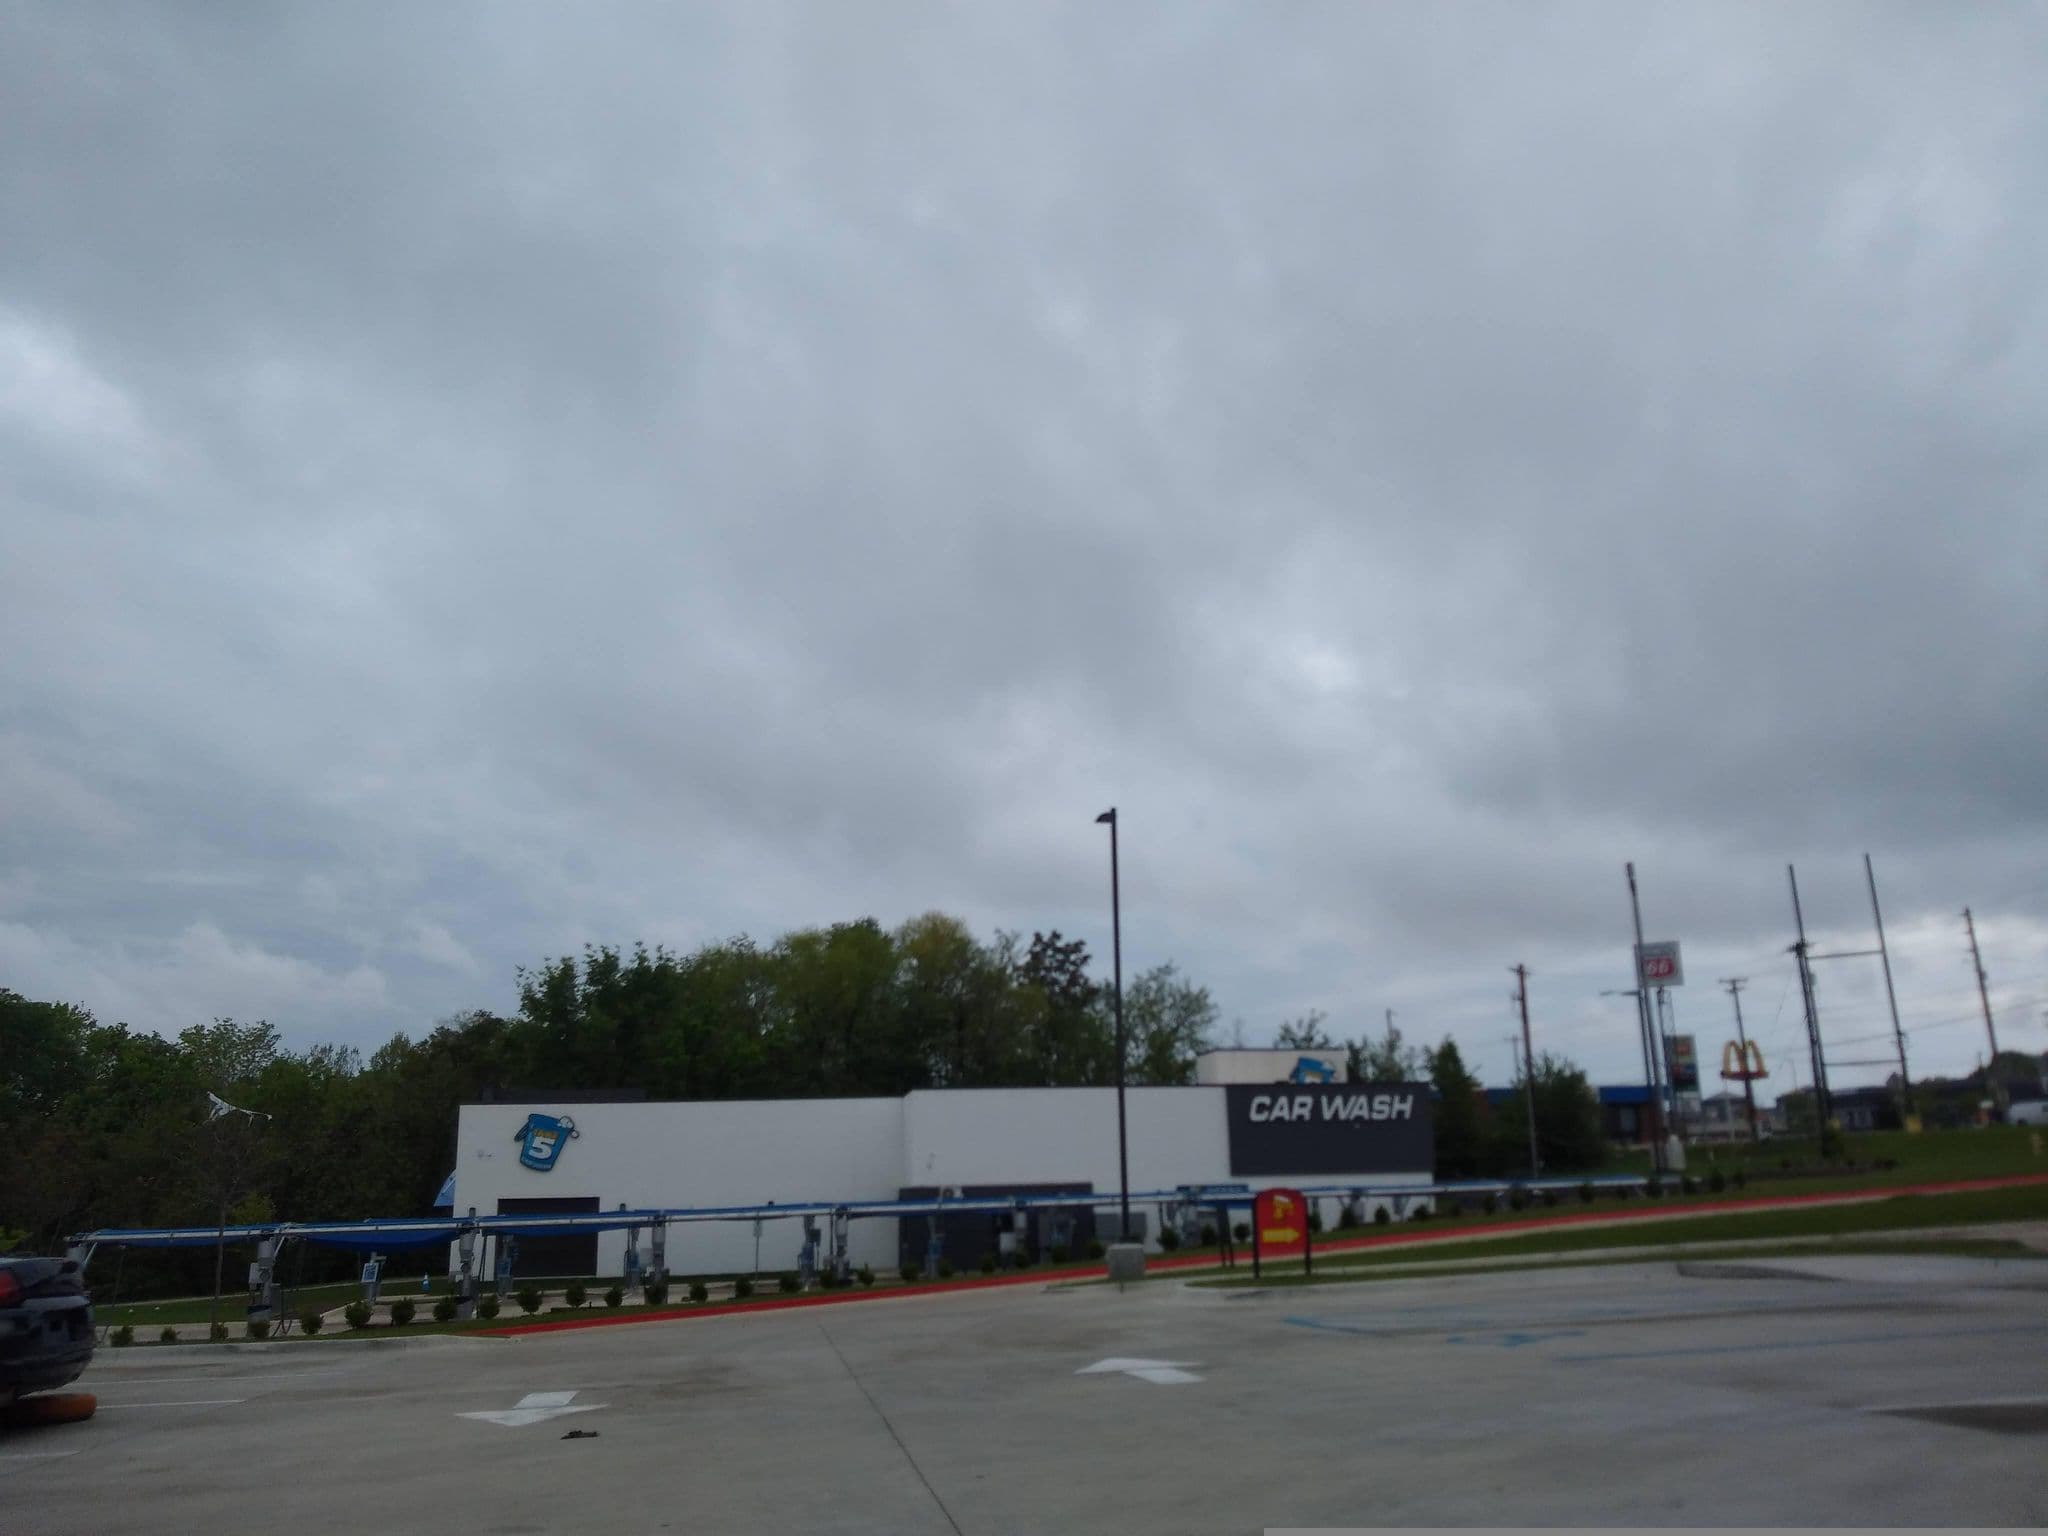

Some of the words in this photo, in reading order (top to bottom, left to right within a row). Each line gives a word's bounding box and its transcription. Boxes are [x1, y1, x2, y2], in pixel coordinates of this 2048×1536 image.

[1251, 1096, 1313, 1121] CAR
[1322, 1095, 1413, 1120] WASH
[528, 1137, 556, 1160] 5
